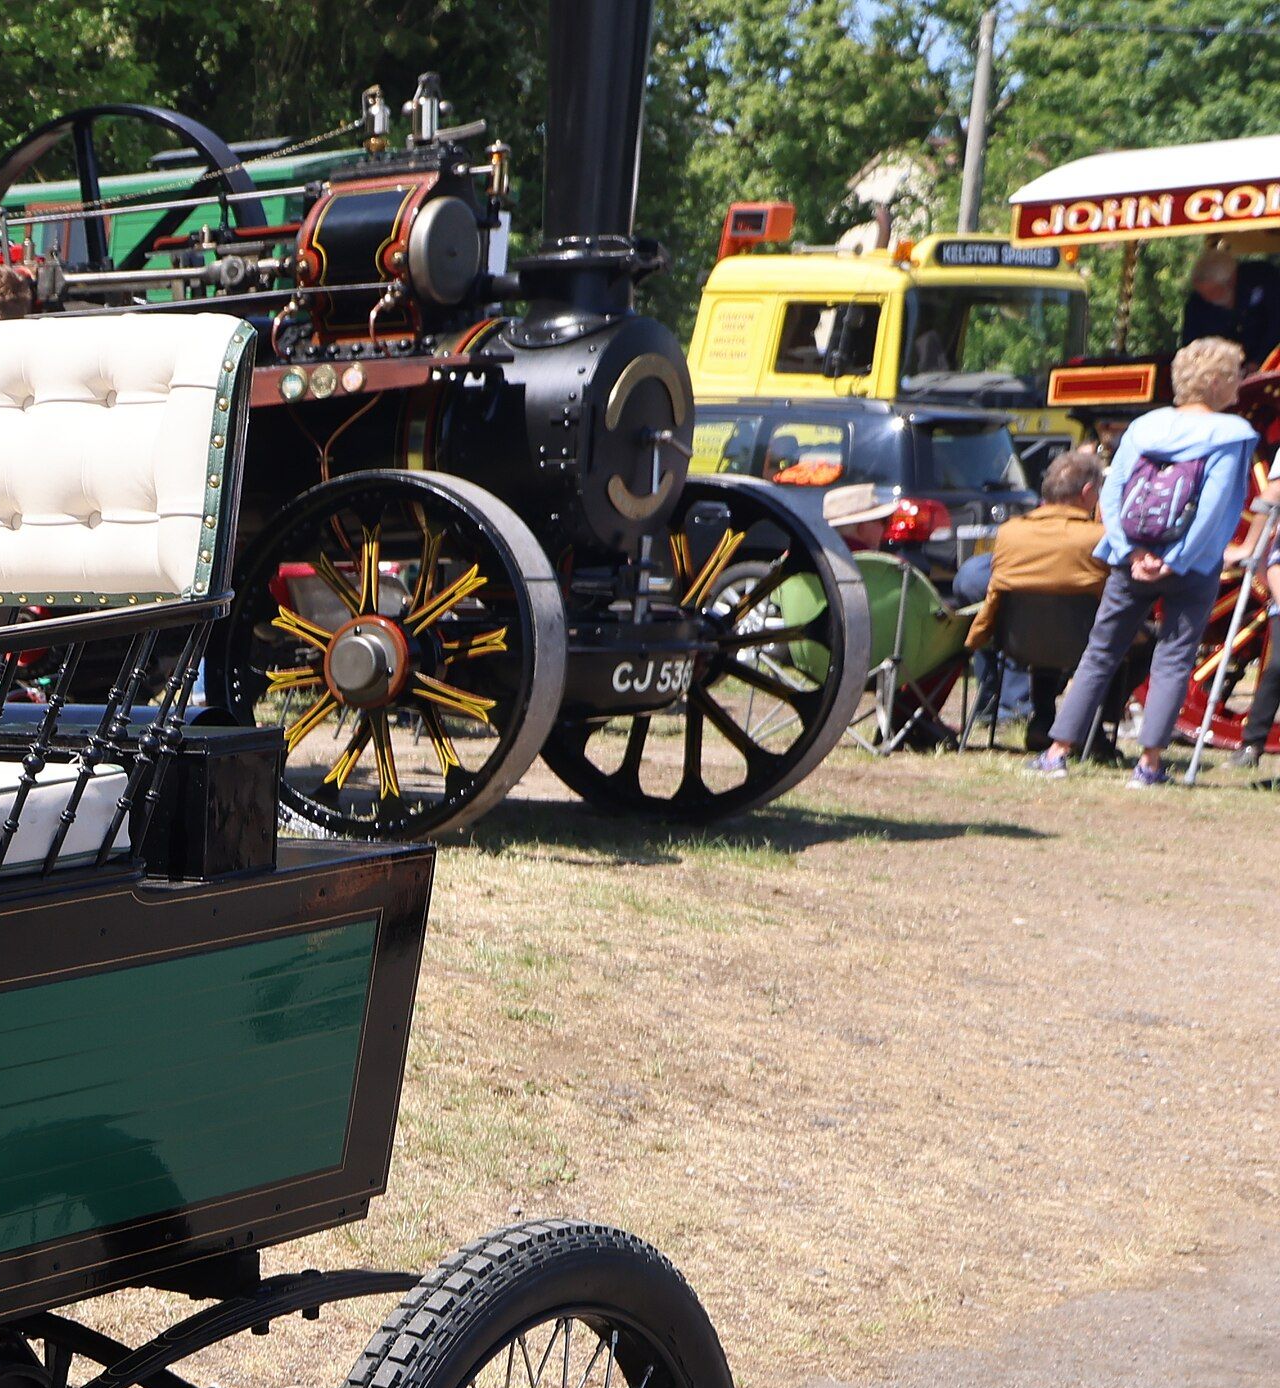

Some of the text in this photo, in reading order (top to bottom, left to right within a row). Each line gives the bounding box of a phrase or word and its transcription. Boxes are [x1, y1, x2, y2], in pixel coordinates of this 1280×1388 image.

[1032, 193, 1174, 236] JOHN
[942, 244, 1052, 265] KELSTON SPARKES
[612, 661, 655, 693] CJ
